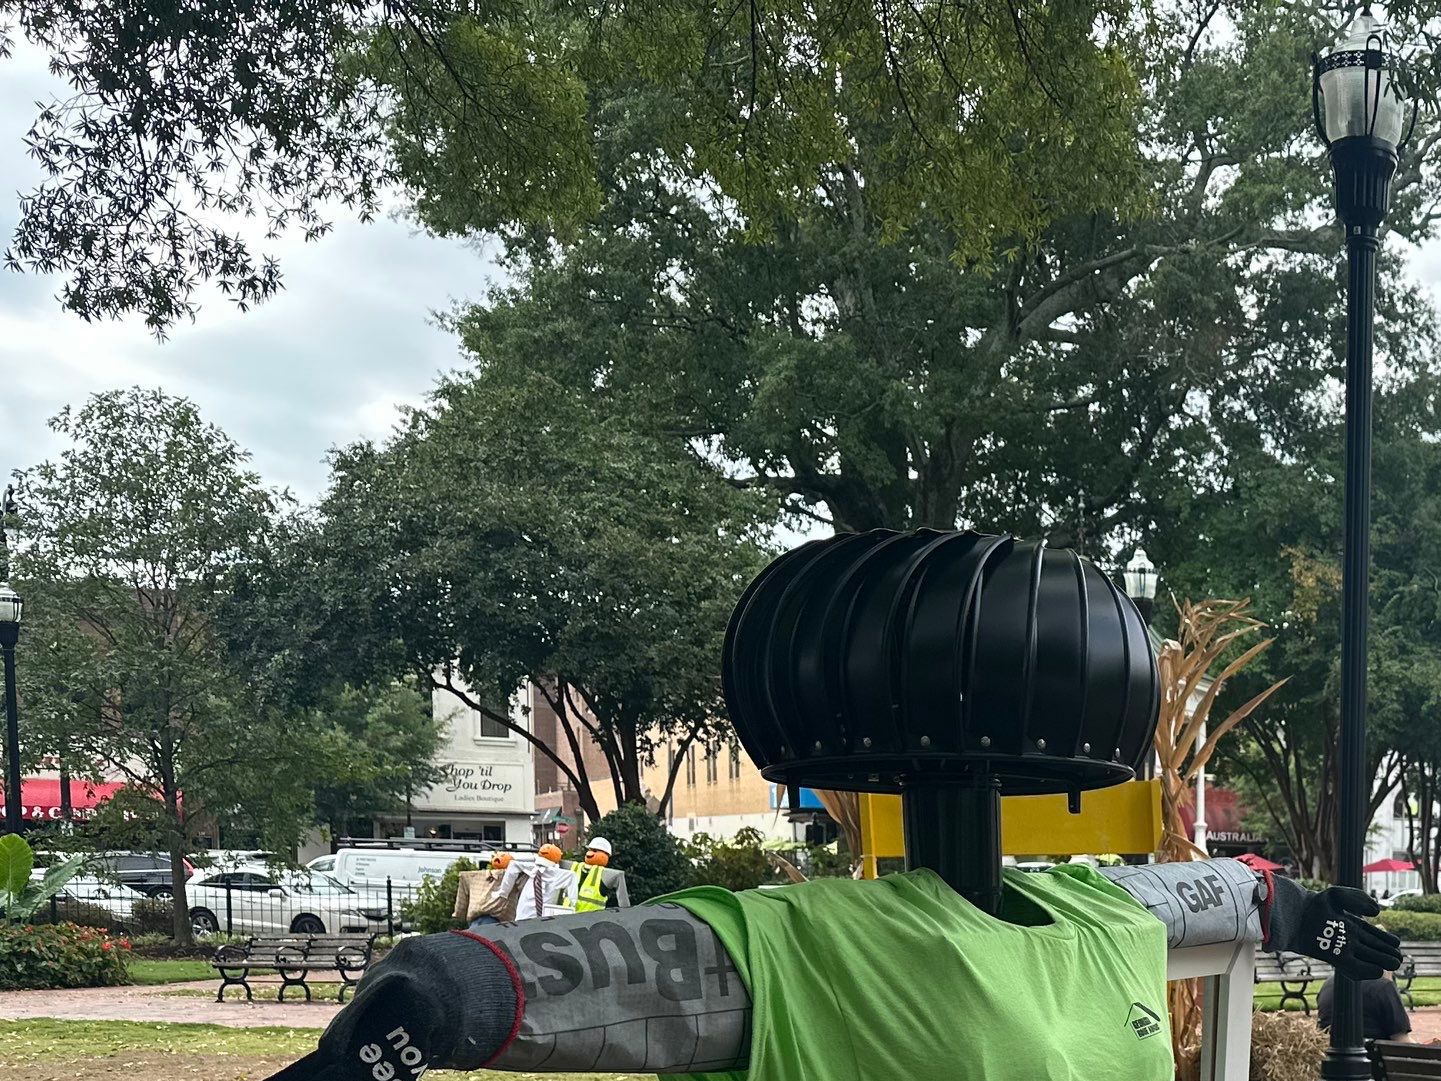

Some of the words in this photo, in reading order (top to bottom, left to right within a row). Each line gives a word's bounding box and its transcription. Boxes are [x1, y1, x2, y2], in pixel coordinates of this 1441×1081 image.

[478, 766, 493, 777] 'til
[446, 779, 478, 792] You
[480, 779, 513, 793] Drop
[1176, 874, 1224, 914] GAF
[1316, 920, 1338, 950] top
[1338, 920, 1346, 934] at
[1332, 935, 1347, 955] the
